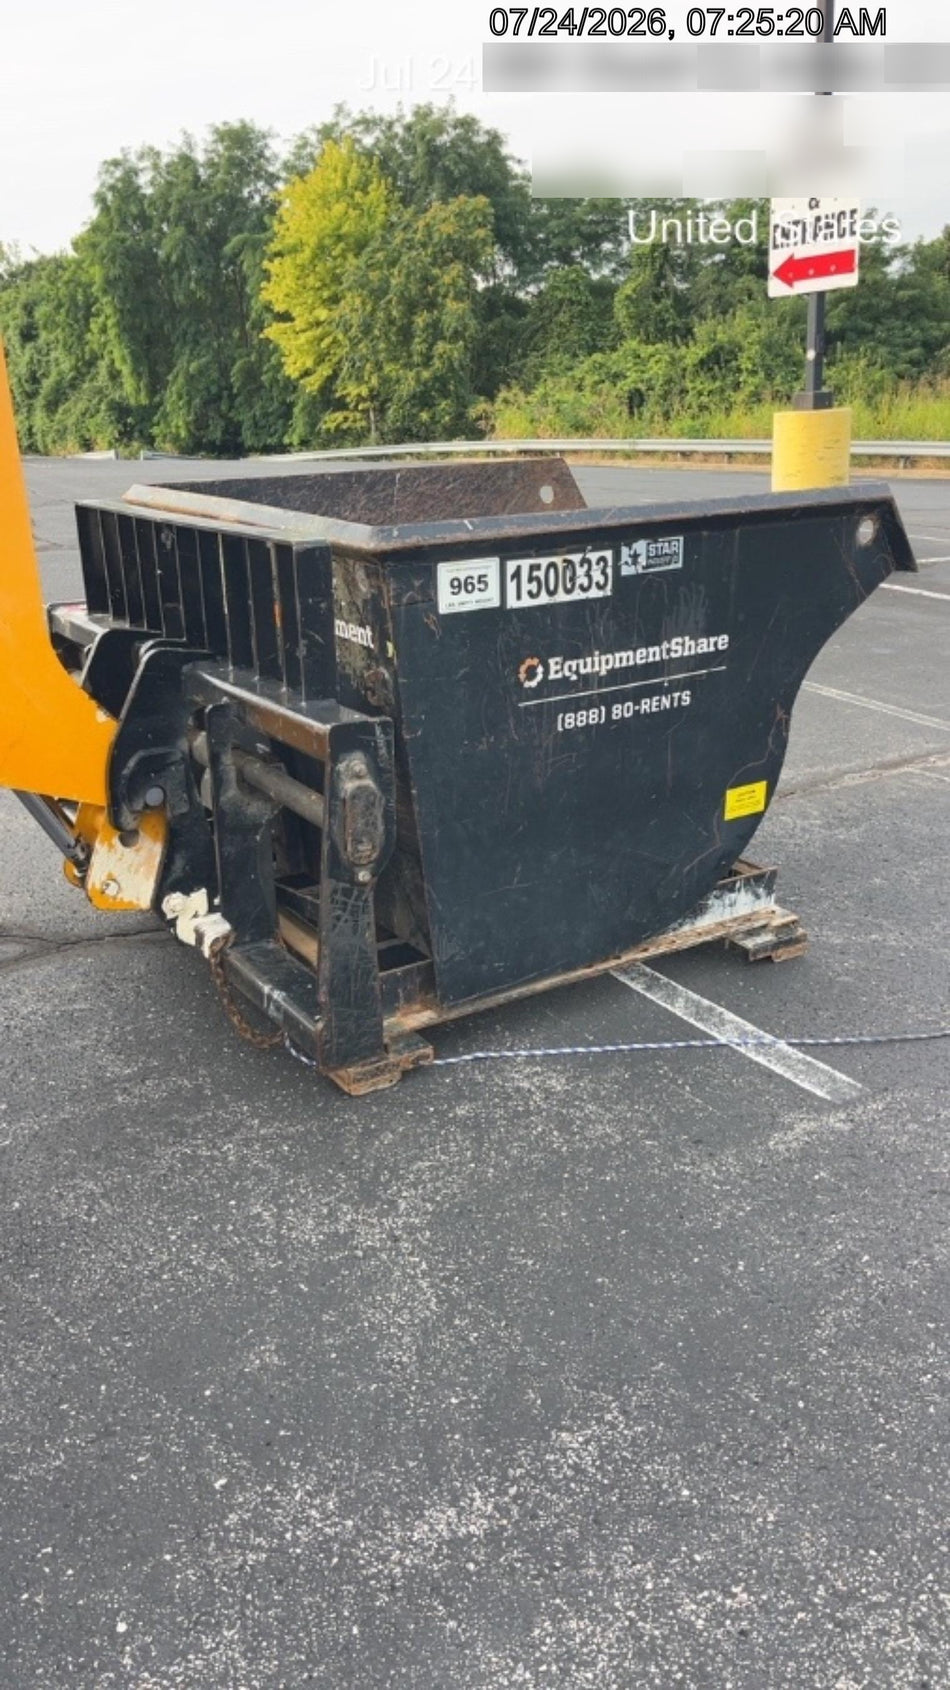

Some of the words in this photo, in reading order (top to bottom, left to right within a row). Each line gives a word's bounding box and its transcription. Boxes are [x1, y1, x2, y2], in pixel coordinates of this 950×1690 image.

[648, 540, 679, 557] STAR
[450, 574, 489, 596] 965
[509, 555, 610, 601] 150033
[547, 634, 730, 681] EquipmentShare
[557, 705, 606, 731] (888)
[611, 690, 692, 721] 80-RENTS
